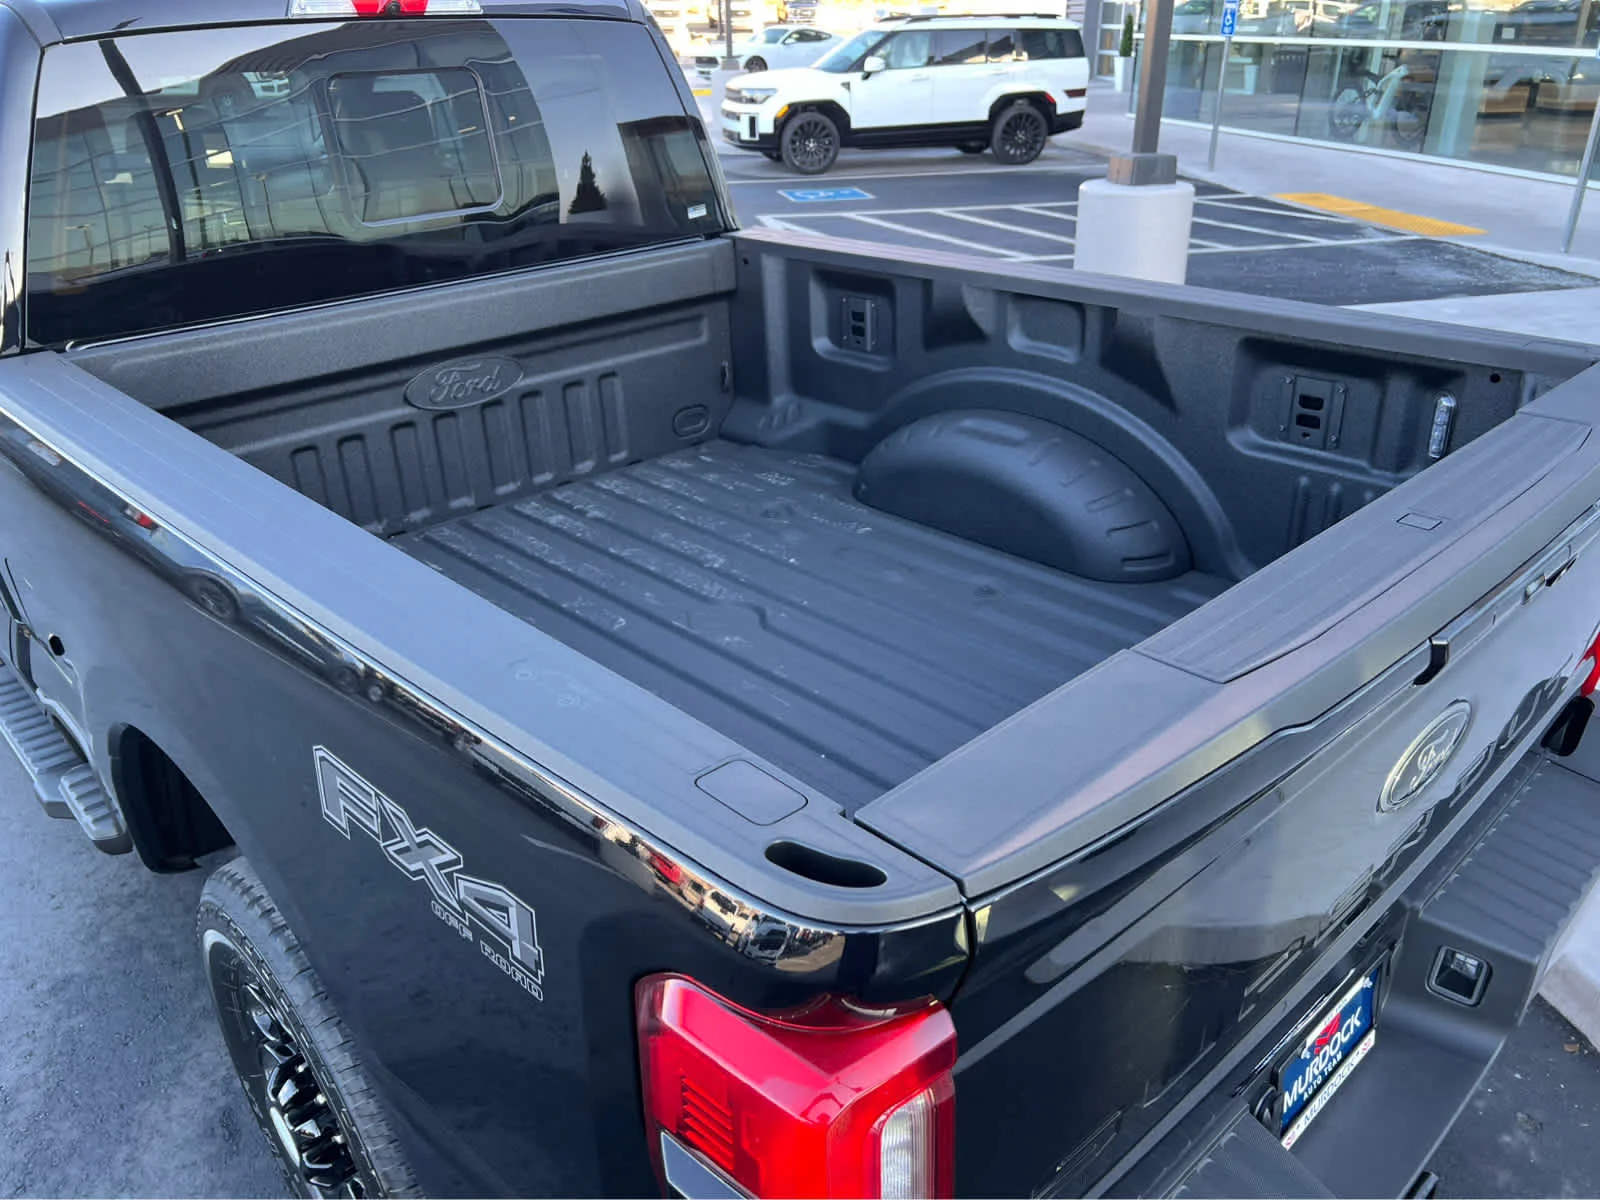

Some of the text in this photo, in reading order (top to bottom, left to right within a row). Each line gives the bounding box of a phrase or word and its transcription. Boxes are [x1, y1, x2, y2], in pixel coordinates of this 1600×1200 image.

[429, 361, 501, 404] Ford
[313, 745, 545, 985] FX4
[1283, 1006, 1362, 1112] MURDOCK
[1303, 1075, 1323, 1101] AUTO
[1323, 1050, 1343, 1076] TEAM
